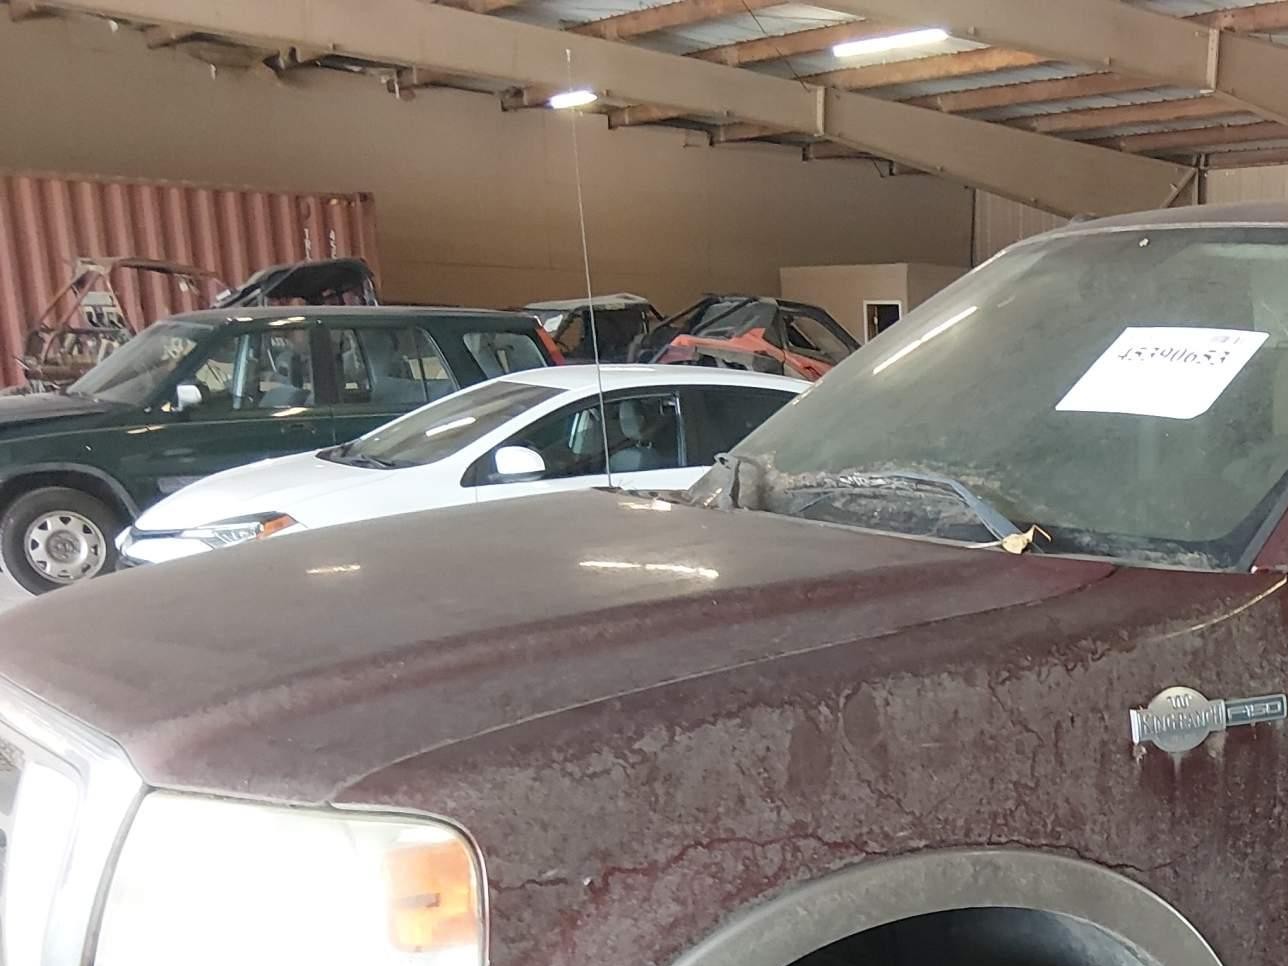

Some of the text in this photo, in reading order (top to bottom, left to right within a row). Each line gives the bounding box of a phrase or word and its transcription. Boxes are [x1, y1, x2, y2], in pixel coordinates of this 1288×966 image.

[1117, 347, 1231, 366] 45390653
[1142, 704, 1222, 735] KING RANCH
